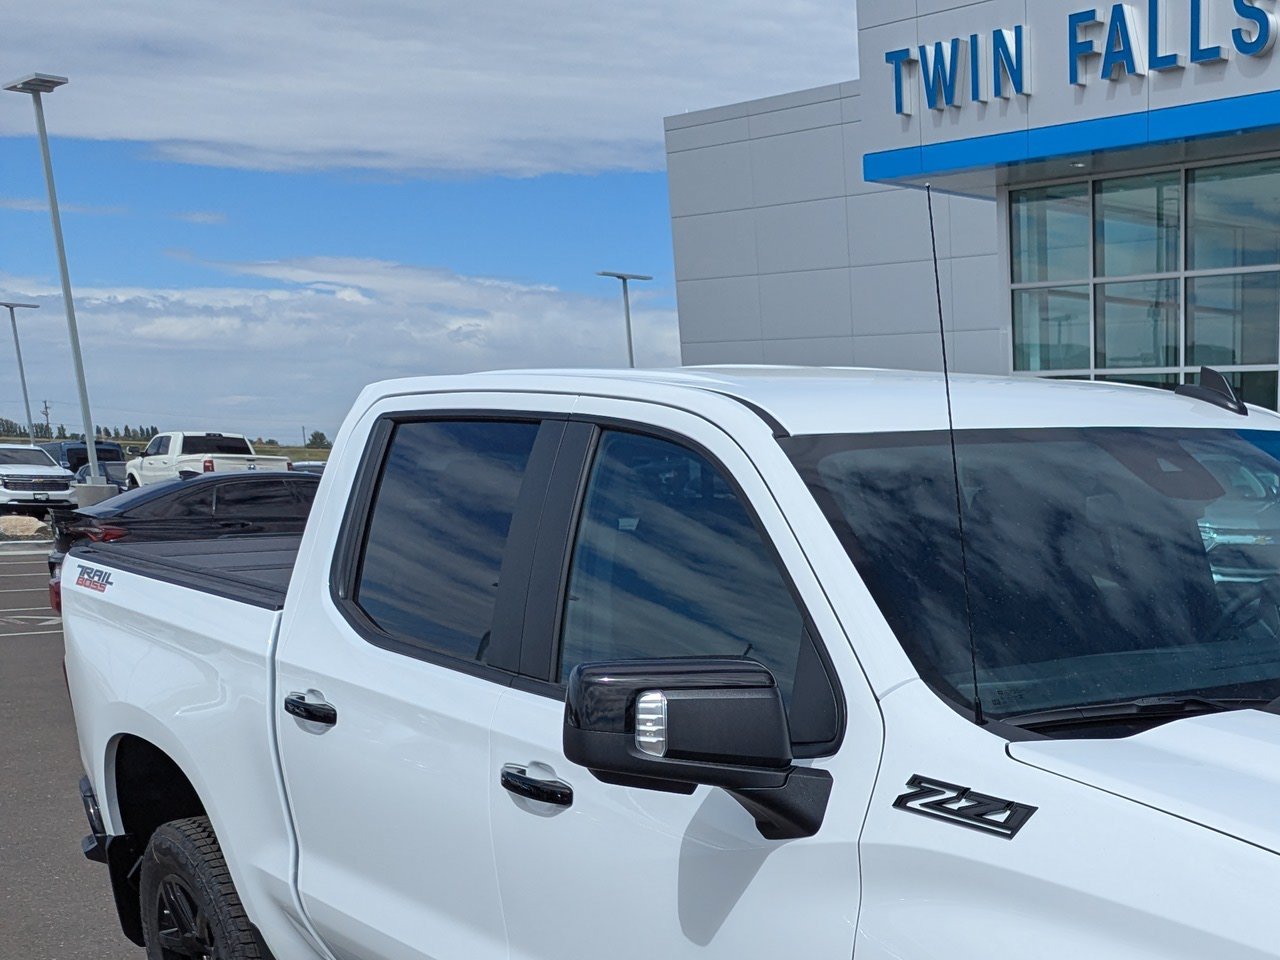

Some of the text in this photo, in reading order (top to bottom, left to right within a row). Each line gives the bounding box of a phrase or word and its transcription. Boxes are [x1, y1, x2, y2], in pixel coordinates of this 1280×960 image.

[885, 0, 1278, 116] TWIN FALLS
[75, 576, 108, 593] BOSS
[77, 564, 114, 586] TRAIL
[892, 773, 1039, 841] Z71
